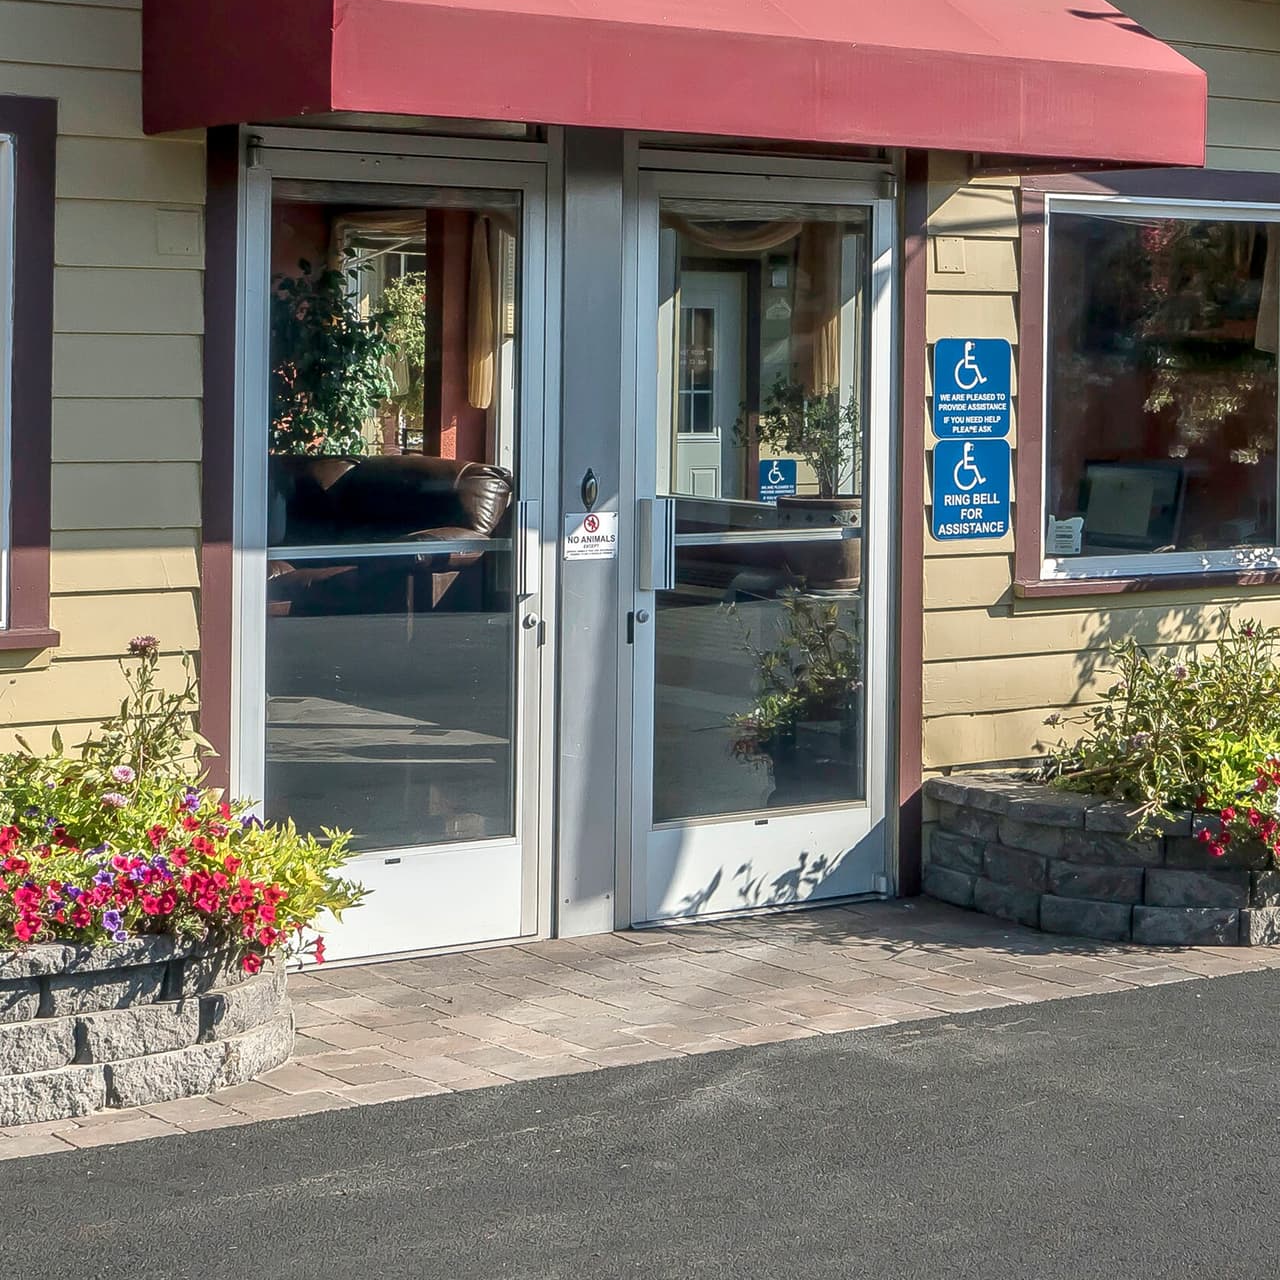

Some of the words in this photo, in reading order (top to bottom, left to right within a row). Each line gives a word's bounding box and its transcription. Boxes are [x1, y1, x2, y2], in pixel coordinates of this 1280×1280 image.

[966, 393, 995, 401] PLEASED
[996, 393, 1006, 401] TO
[938, 403, 967, 411] PROVIDE
[967, 403, 1007, 411] ASSISTANCE
[943, 416, 950, 424] IF
[950, 416, 965, 424] YOU
[965, 416, 983, 424] NEED
[984, 415, 1001, 423] HELP
[978, 425, 992, 433] ASK
[944, 494, 971, 506] RING
[974, 492, 1000, 505] BELL
[960, 508, 983, 520] FOR
[938, 521, 1004, 535] ASSISTANCE
[567, 536, 580, 544] NO
[580, 535, 616, 543] ANIMALS
